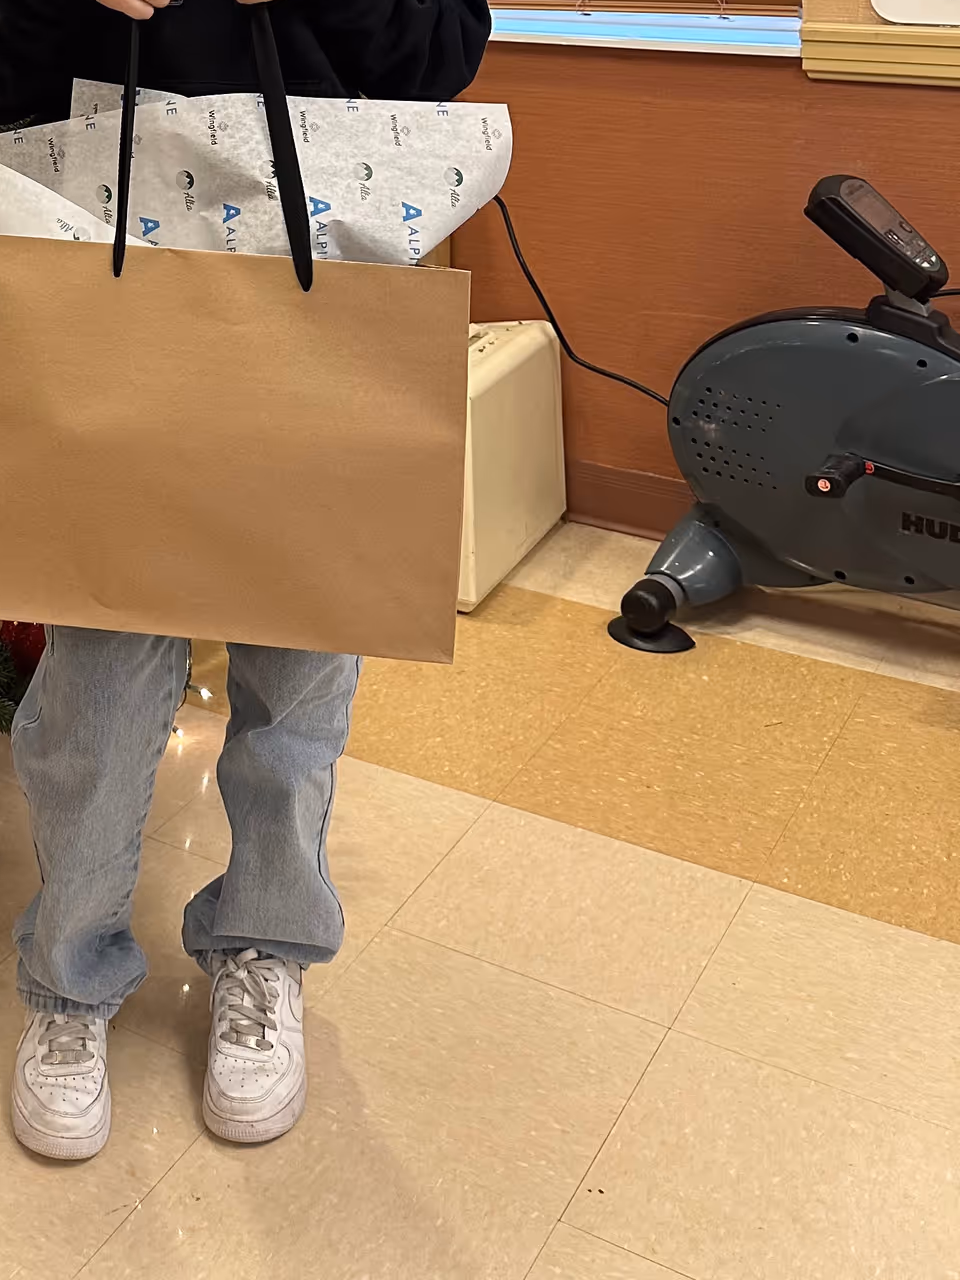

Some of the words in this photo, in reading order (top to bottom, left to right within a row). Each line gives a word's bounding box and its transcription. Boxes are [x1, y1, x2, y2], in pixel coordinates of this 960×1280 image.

[208, 110, 218, 146] Wingfield
[300, 110, 310, 143] Wingfield
[390, 114, 402, 146] Wingfield
[481, 117, 492, 151] Wingfield
[48, 138, 60, 173] Wingfield
[184, 191, 196, 211] Alta
[265, 180, 277, 201] Alta
[359, 182, 372, 201] Alta
[450, 188, 462, 208] Alta
[56, 218, 74, 232] Alta
[102, 205, 114, 224] Alta
